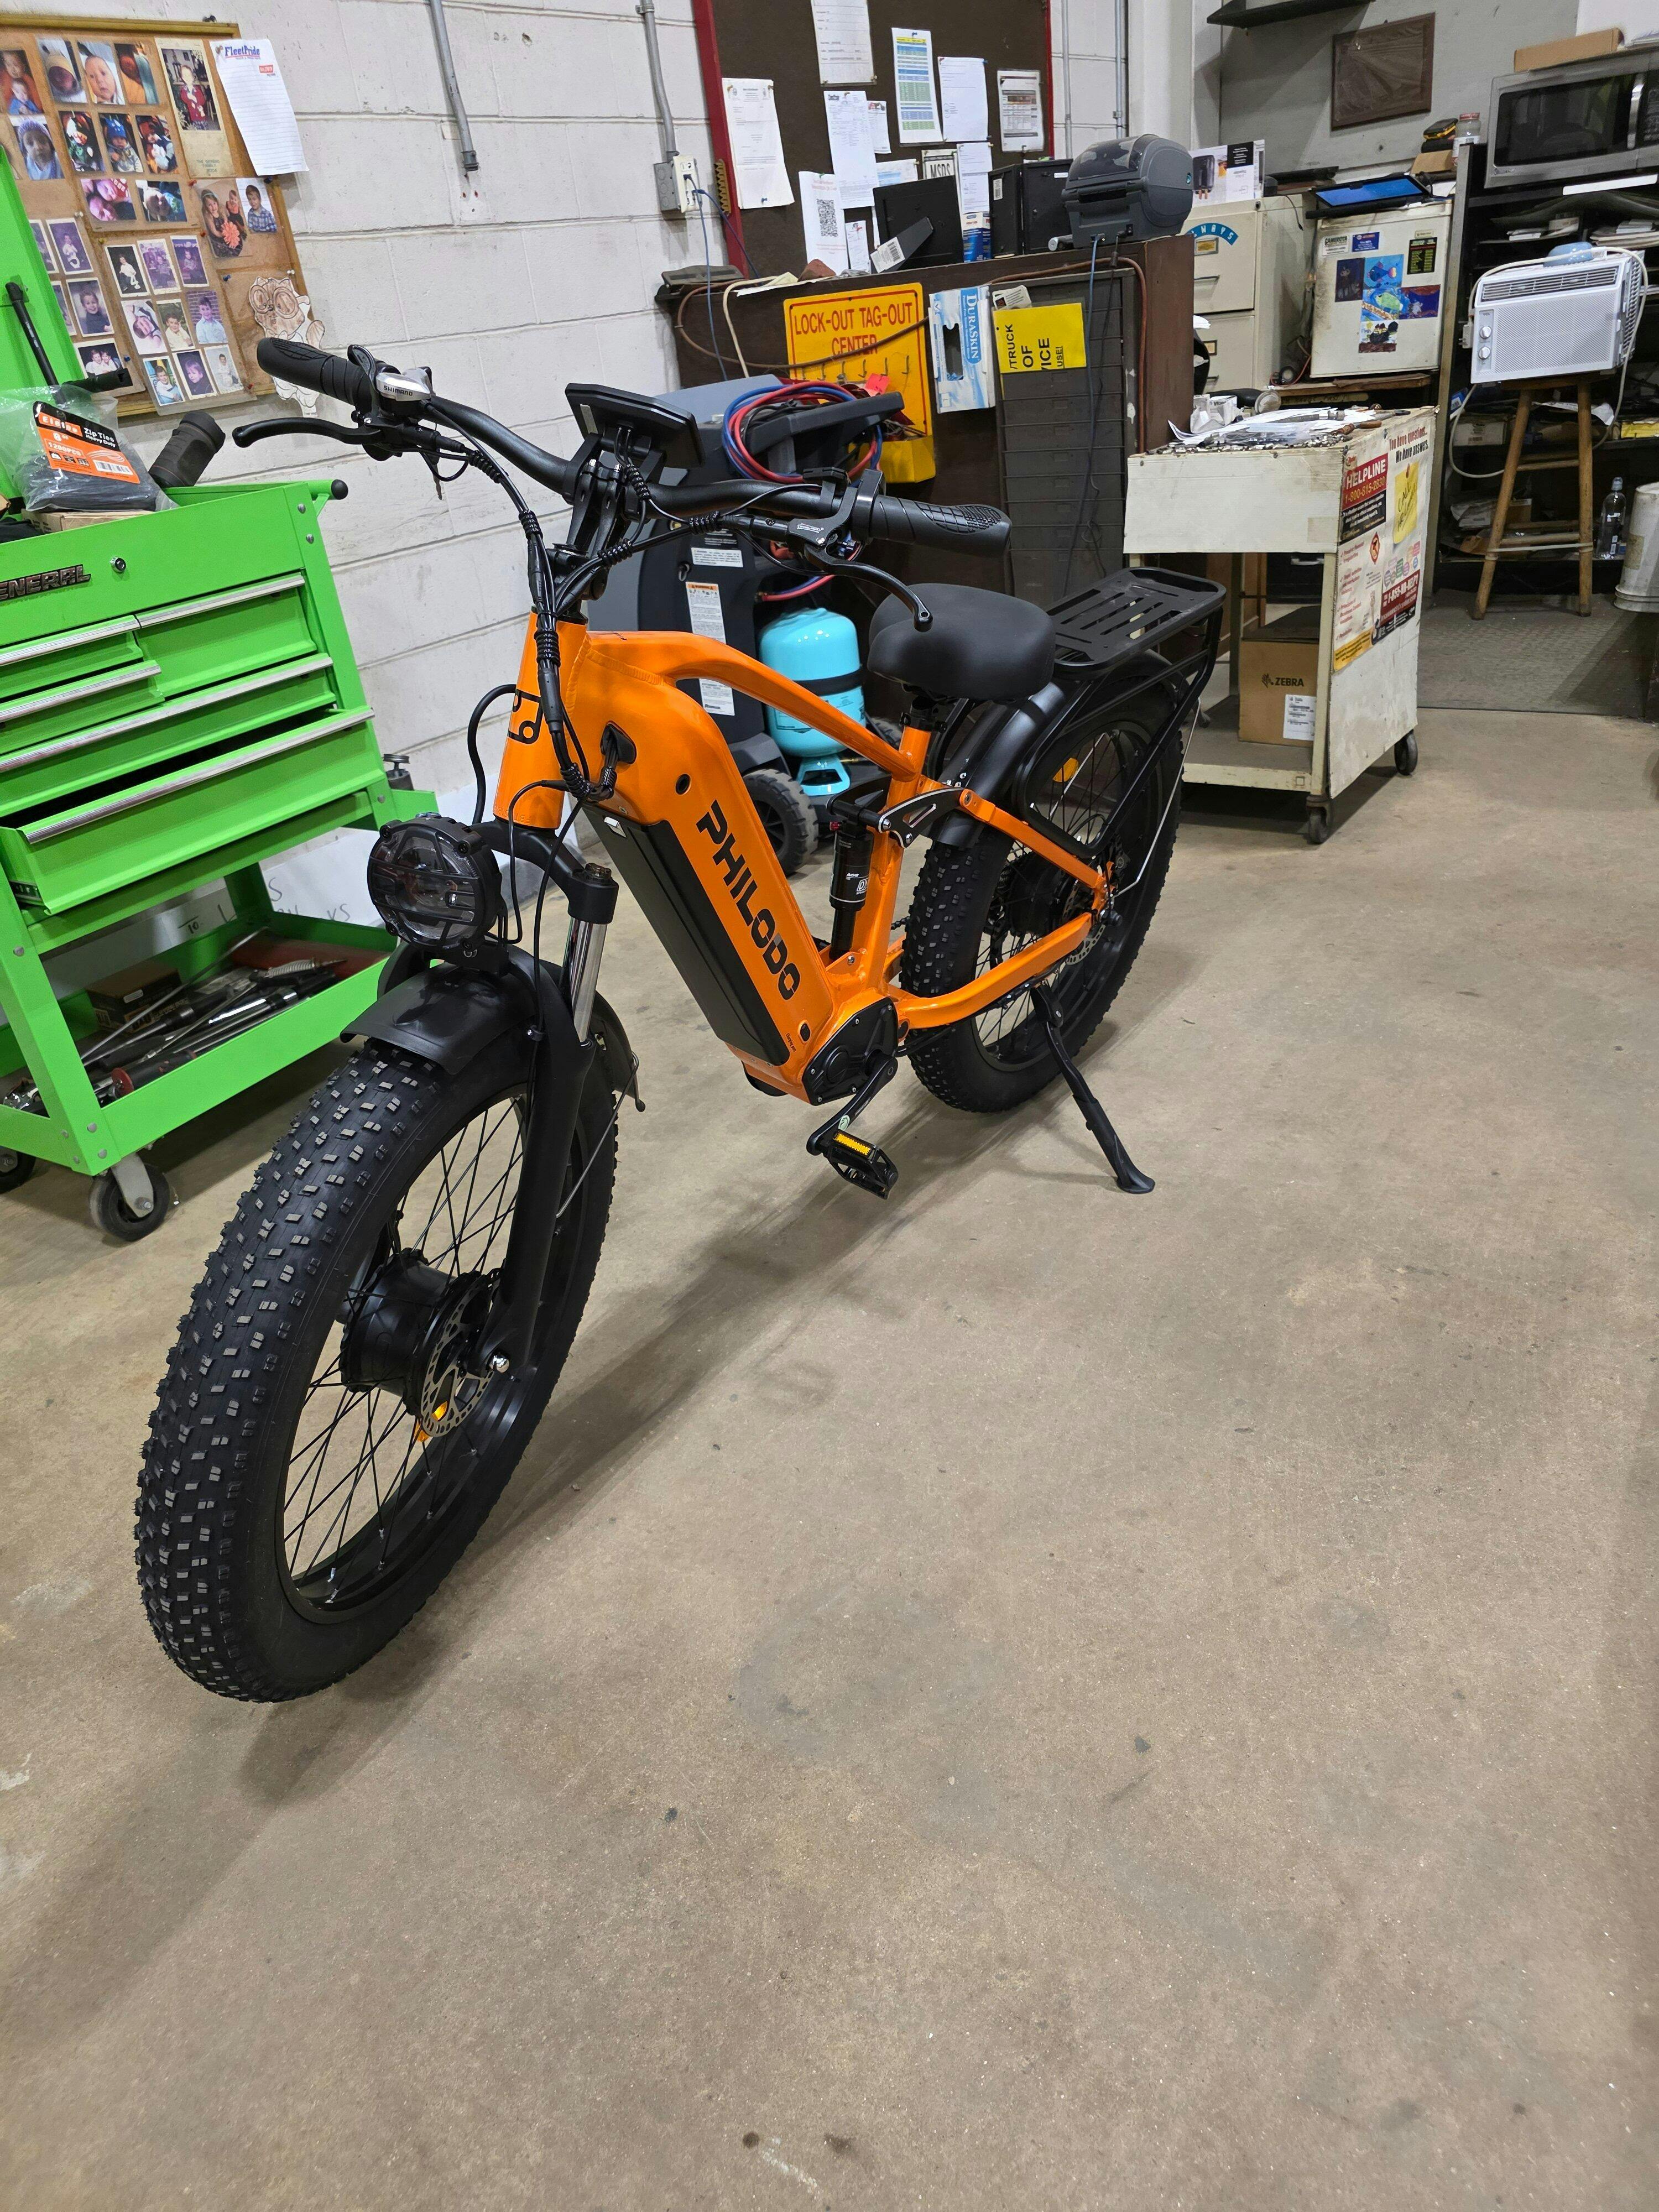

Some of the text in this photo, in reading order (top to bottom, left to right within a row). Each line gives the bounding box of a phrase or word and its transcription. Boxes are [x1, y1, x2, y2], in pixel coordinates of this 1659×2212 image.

[225, 45, 260, 56] FleetPride
[930, 163, 951, 178] MSDS
[794, 302, 913, 335] LOCK-OUT TAG-OUT
[832, 334, 878, 356] CENTER
[1021, 345, 1034, 368] OF
[383, 385, 413, 396] SHIMANO
[84, 427, 114, 442] Zip Ties
[85, 434, 116, 448] Heavy Duty
[1397, 435, 1407, 447] have
[48, 442, 82, 456] 1200PCS
[1395, 450, 1402, 463] We
[1402, 447, 1412, 460] have
[1346, 459, 1386, 489] HELPLINE
[1275, 677, 1304, 686] ZEBRA
[696, 799, 800, 1000] PHILODO
